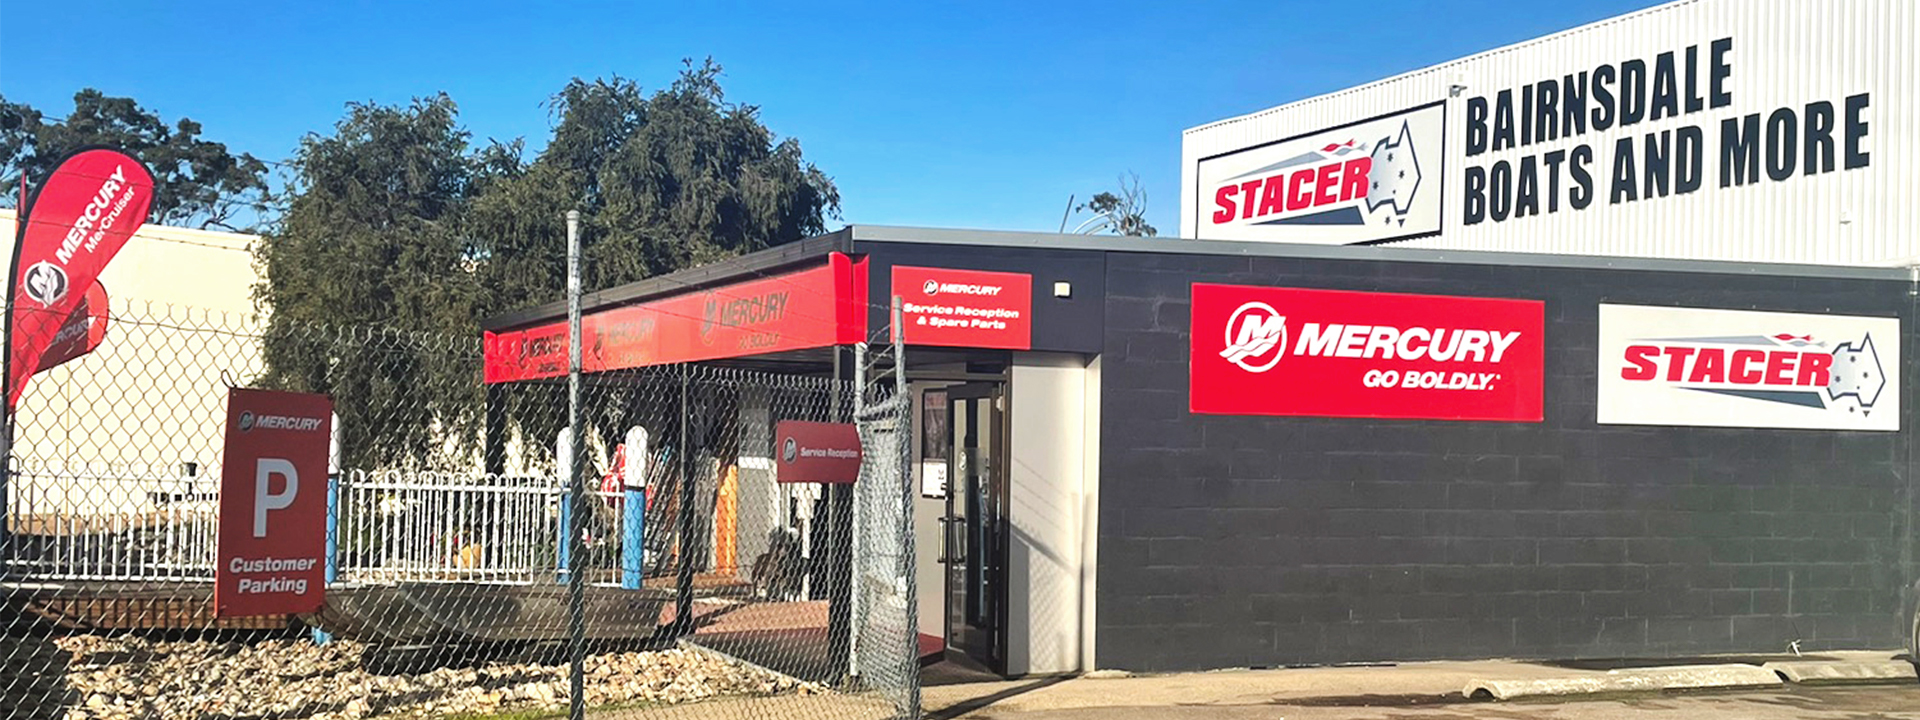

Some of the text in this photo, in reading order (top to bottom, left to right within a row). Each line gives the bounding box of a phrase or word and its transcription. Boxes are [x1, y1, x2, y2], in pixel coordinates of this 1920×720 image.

[1465, 36, 1733, 157] BAIRNSDALE
[1463, 92, 1871, 226] BOATS AND MORE
[1212, 156, 1373, 225] STACER
[55, 164, 126, 266] MERCURY
[84, 186, 135, 254] MerCruiser
[939, 283, 1002, 296] MERCURY
[720, 290, 790, 327] MERCURY
[902, 302, 1020, 319] Service Reception
[916, 316, 1007, 330] & Spare Parts
[1294, 322, 1521, 364] MERCURY
[1362, 369, 1400, 388] GO
[1621, 345, 1834, 387] STACER
[255, 415, 323, 431] MERCURY
[800, 446, 859, 460] Service Reception
[253, 458, 299, 538] P
[229, 556, 317, 574] Customer
[238, 577, 308, 595] Parking
